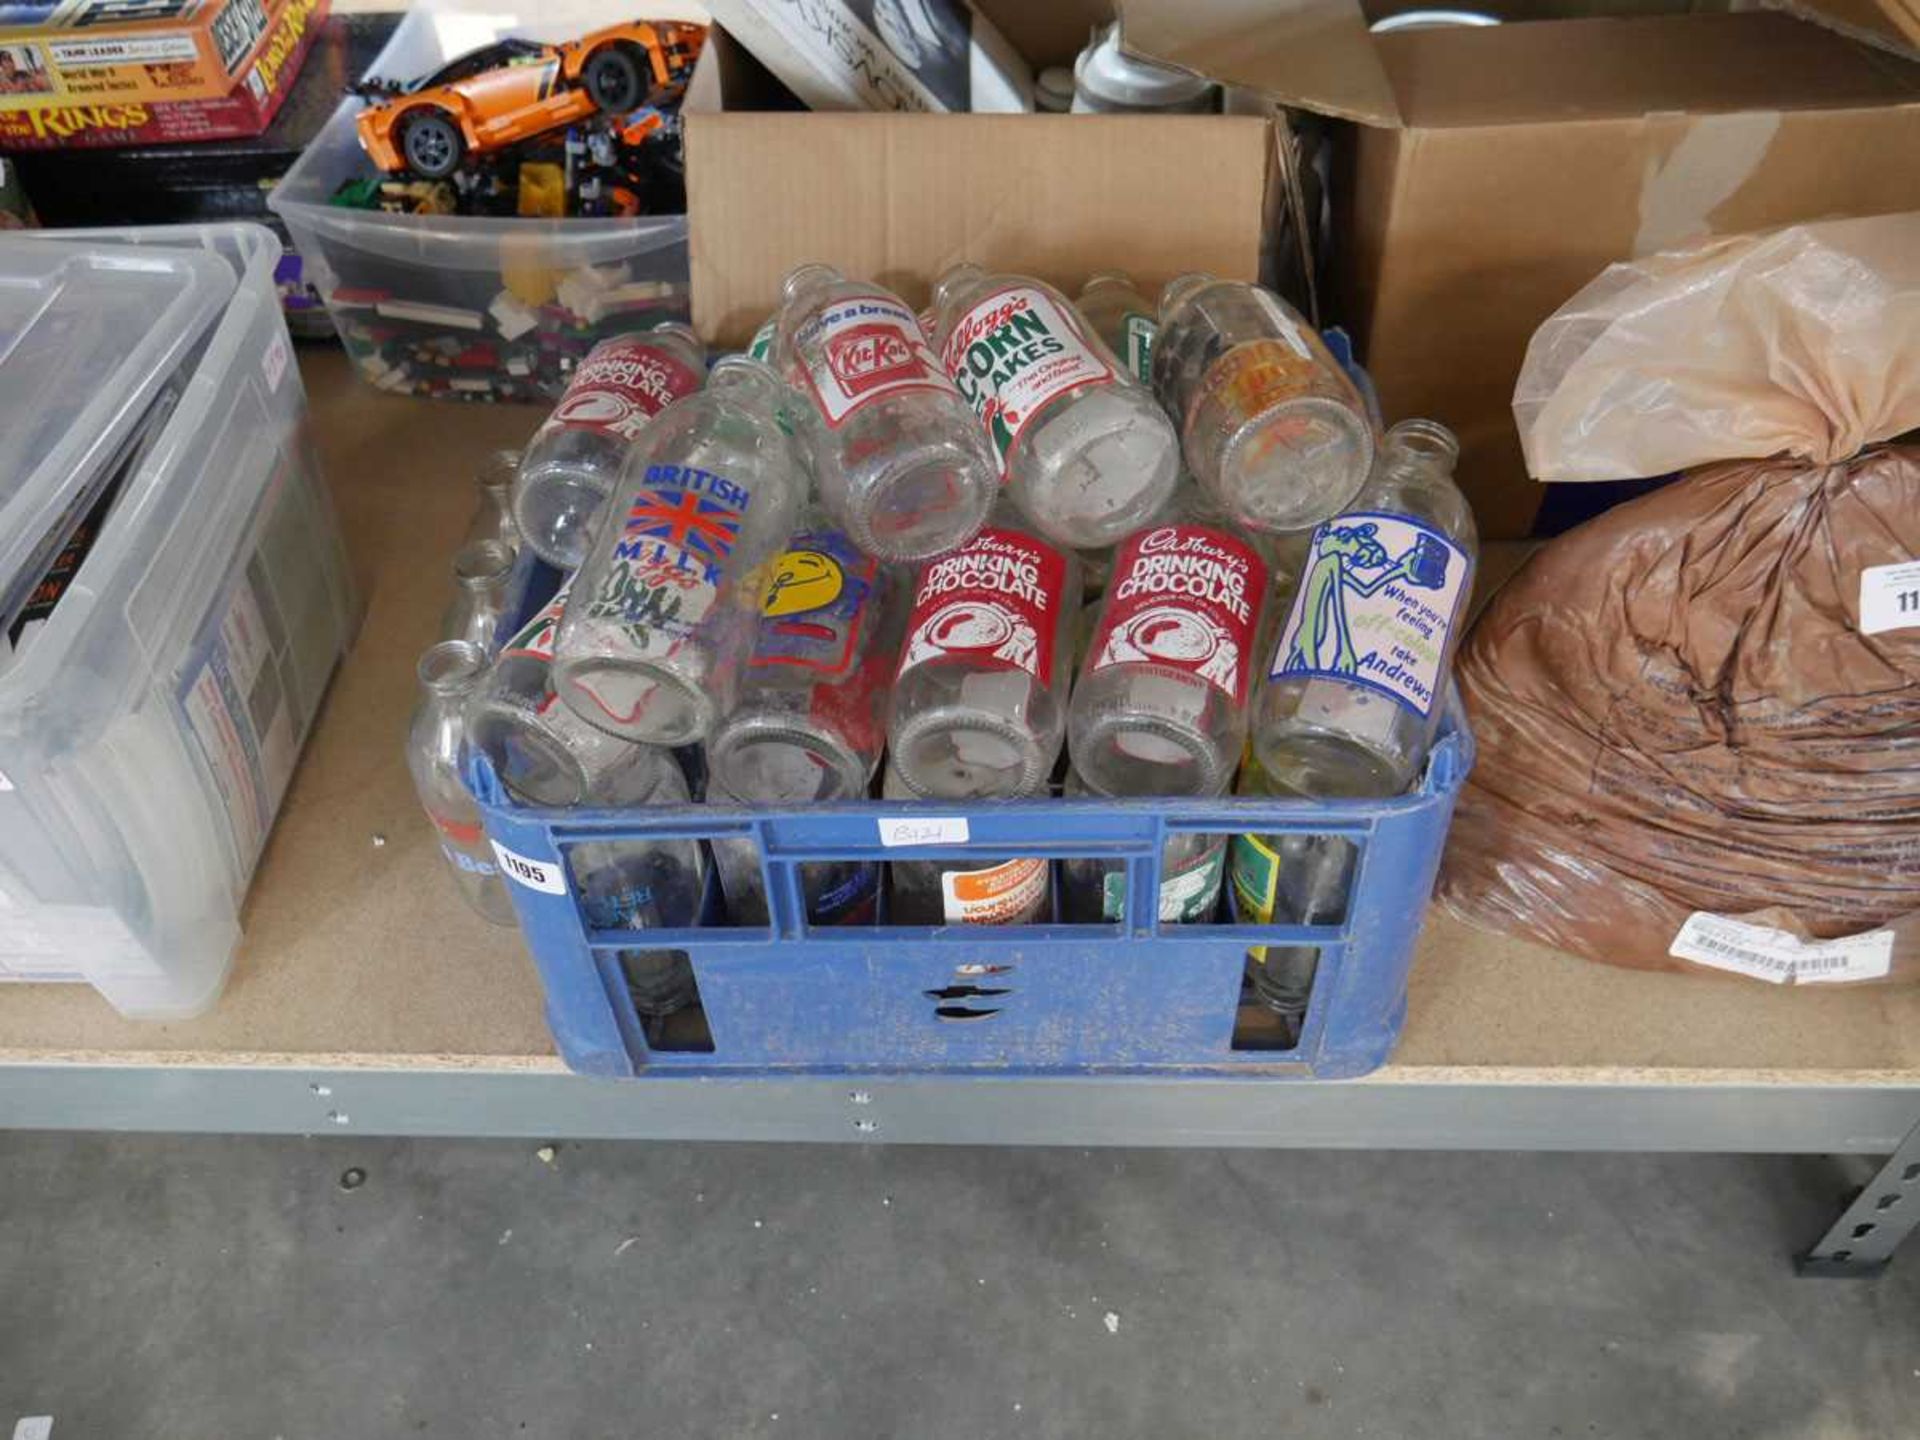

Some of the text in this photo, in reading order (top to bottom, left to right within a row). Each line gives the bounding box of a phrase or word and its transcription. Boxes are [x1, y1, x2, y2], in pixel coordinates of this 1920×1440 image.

[28, 101, 149, 139] RINGS
[956, 308, 1050, 404] CORN
[642, 464, 750, 513] BRITISH
[613, 540, 722, 587] MILK
[928, 553, 1039, 586] DRINKING
[1138, 528, 1250, 574] Cadbury's
[916, 570, 1048, 611] CHOCOLATE
[1131, 554, 1246, 595] DRINKING
[1383, 583, 1420, 609] When
[1116, 572, 1251, 626] CHOCOLATE
[1355, 651, 1433, 704] Andrews
[504, 853, 546, 883] 1195
